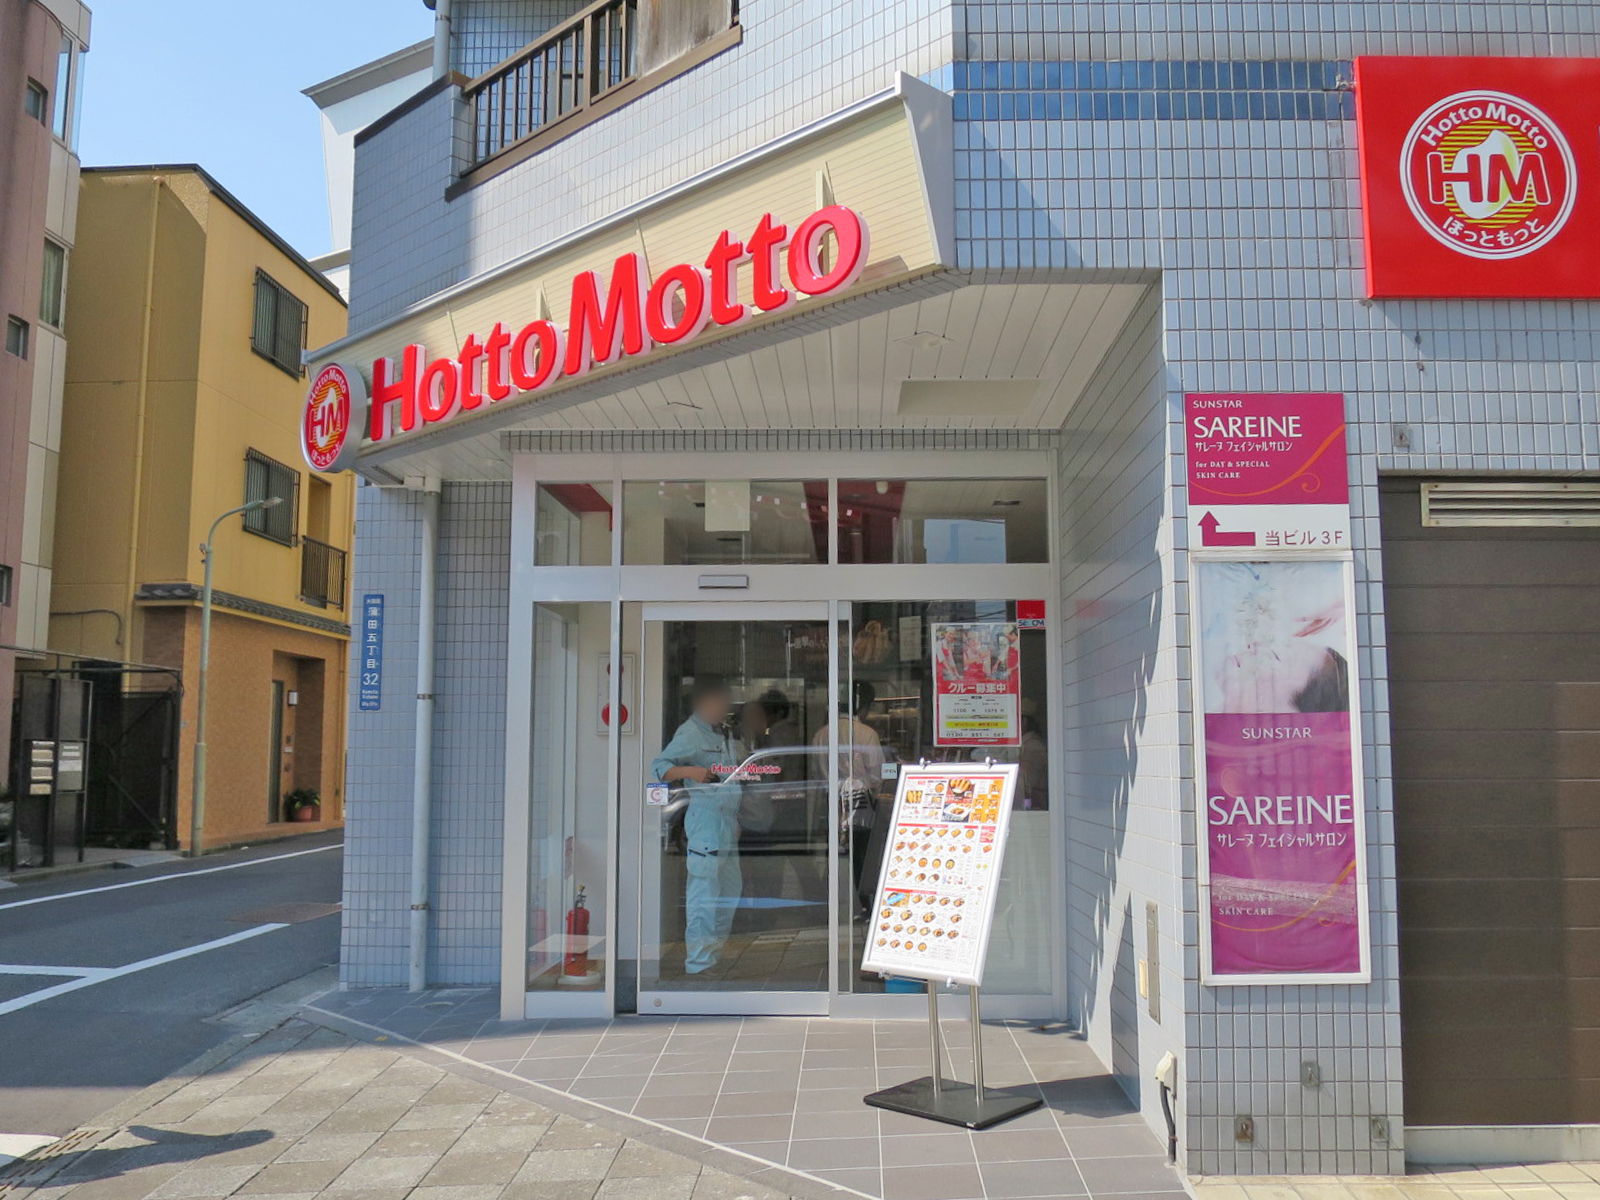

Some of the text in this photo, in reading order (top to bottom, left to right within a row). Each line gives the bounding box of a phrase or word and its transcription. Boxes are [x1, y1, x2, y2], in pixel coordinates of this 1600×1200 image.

[1427, 152, 1551, 205] HM
[1442, 216, 1545, 247] ほっともっと
[1193, 400, 1243, 409] SUNSTAR
[309, 397, 345, 442] HM
[1193, 416, 1303, 439] SAREINE
[311, 443, 342, 465] ほっともっと
[1195, 441, 1293, 452] サレーヌ フェイシャルサロン
[362, 673, 379, 686] 32
[947, 682, 1007, 694] クルー募集中
[1241, 727, 1313, 740] SUNSTAR
[1208, 794, 1354, 826] SAREINE
[1217, 832, 1347, 848] サレーヌ フェイシャルサロン
[1218, 907, 1274, 916] SKIN CARE
